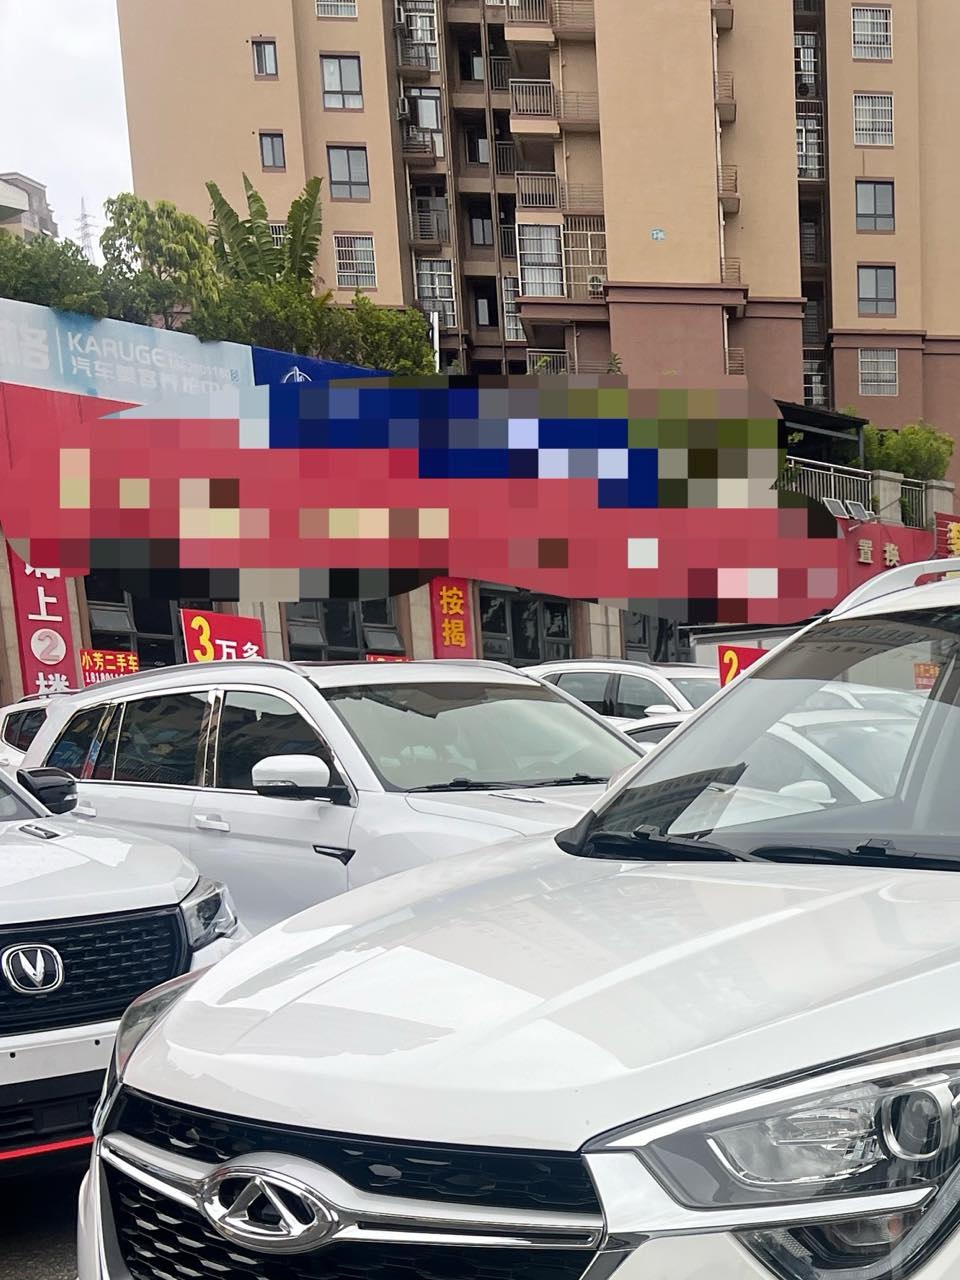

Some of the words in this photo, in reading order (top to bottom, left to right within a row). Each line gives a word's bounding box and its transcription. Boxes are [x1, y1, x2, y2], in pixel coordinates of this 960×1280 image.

[67, 331, 166, 368] KARUGE
[858, 539, 900, 567] 置换
[439, 586, 466, 648] 按揭
[81, 651, 139, 672] 小芳二手车
